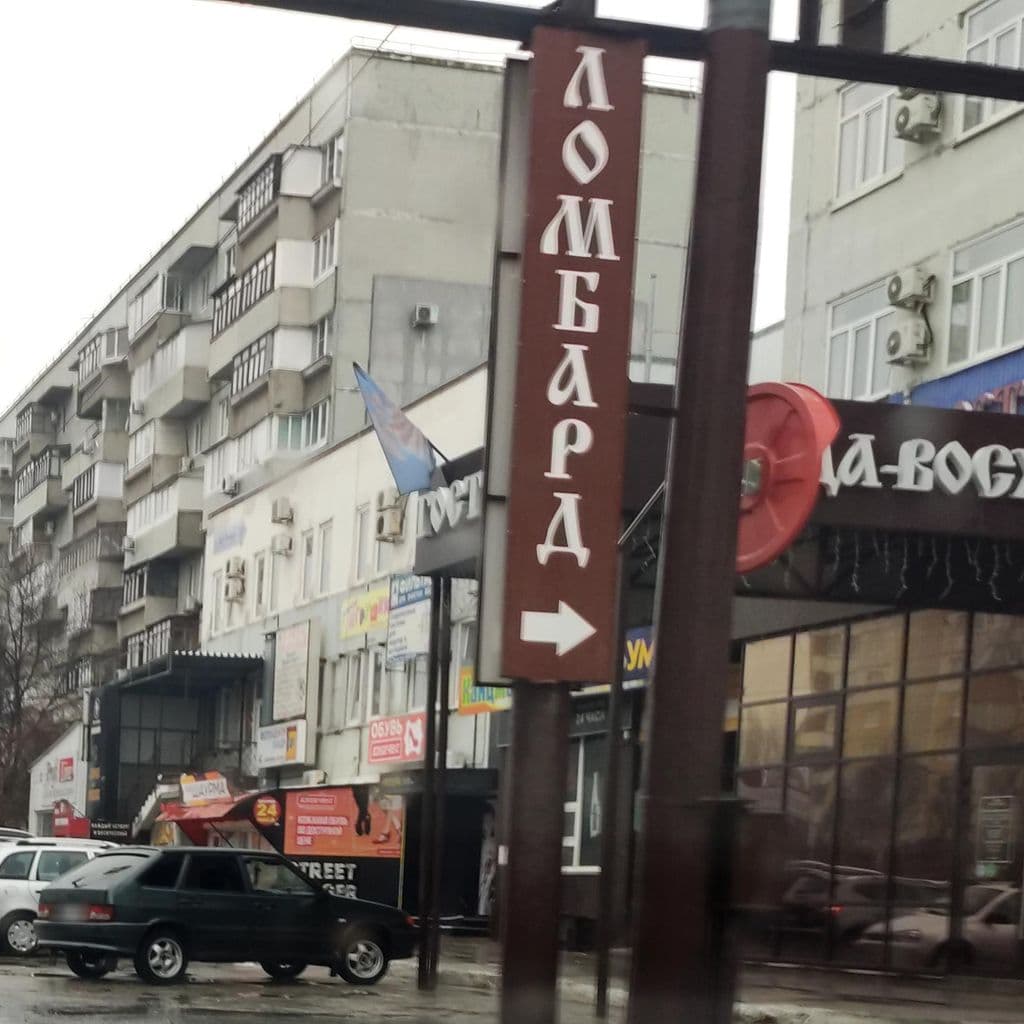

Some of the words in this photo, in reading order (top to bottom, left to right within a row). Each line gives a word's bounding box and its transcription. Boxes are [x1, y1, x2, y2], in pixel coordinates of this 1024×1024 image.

[536, 45, 621, 568] ЛОМБАРД
[371, 717, 403, 740] ОБУВЬ
[257, 803, 278, 818] 24
